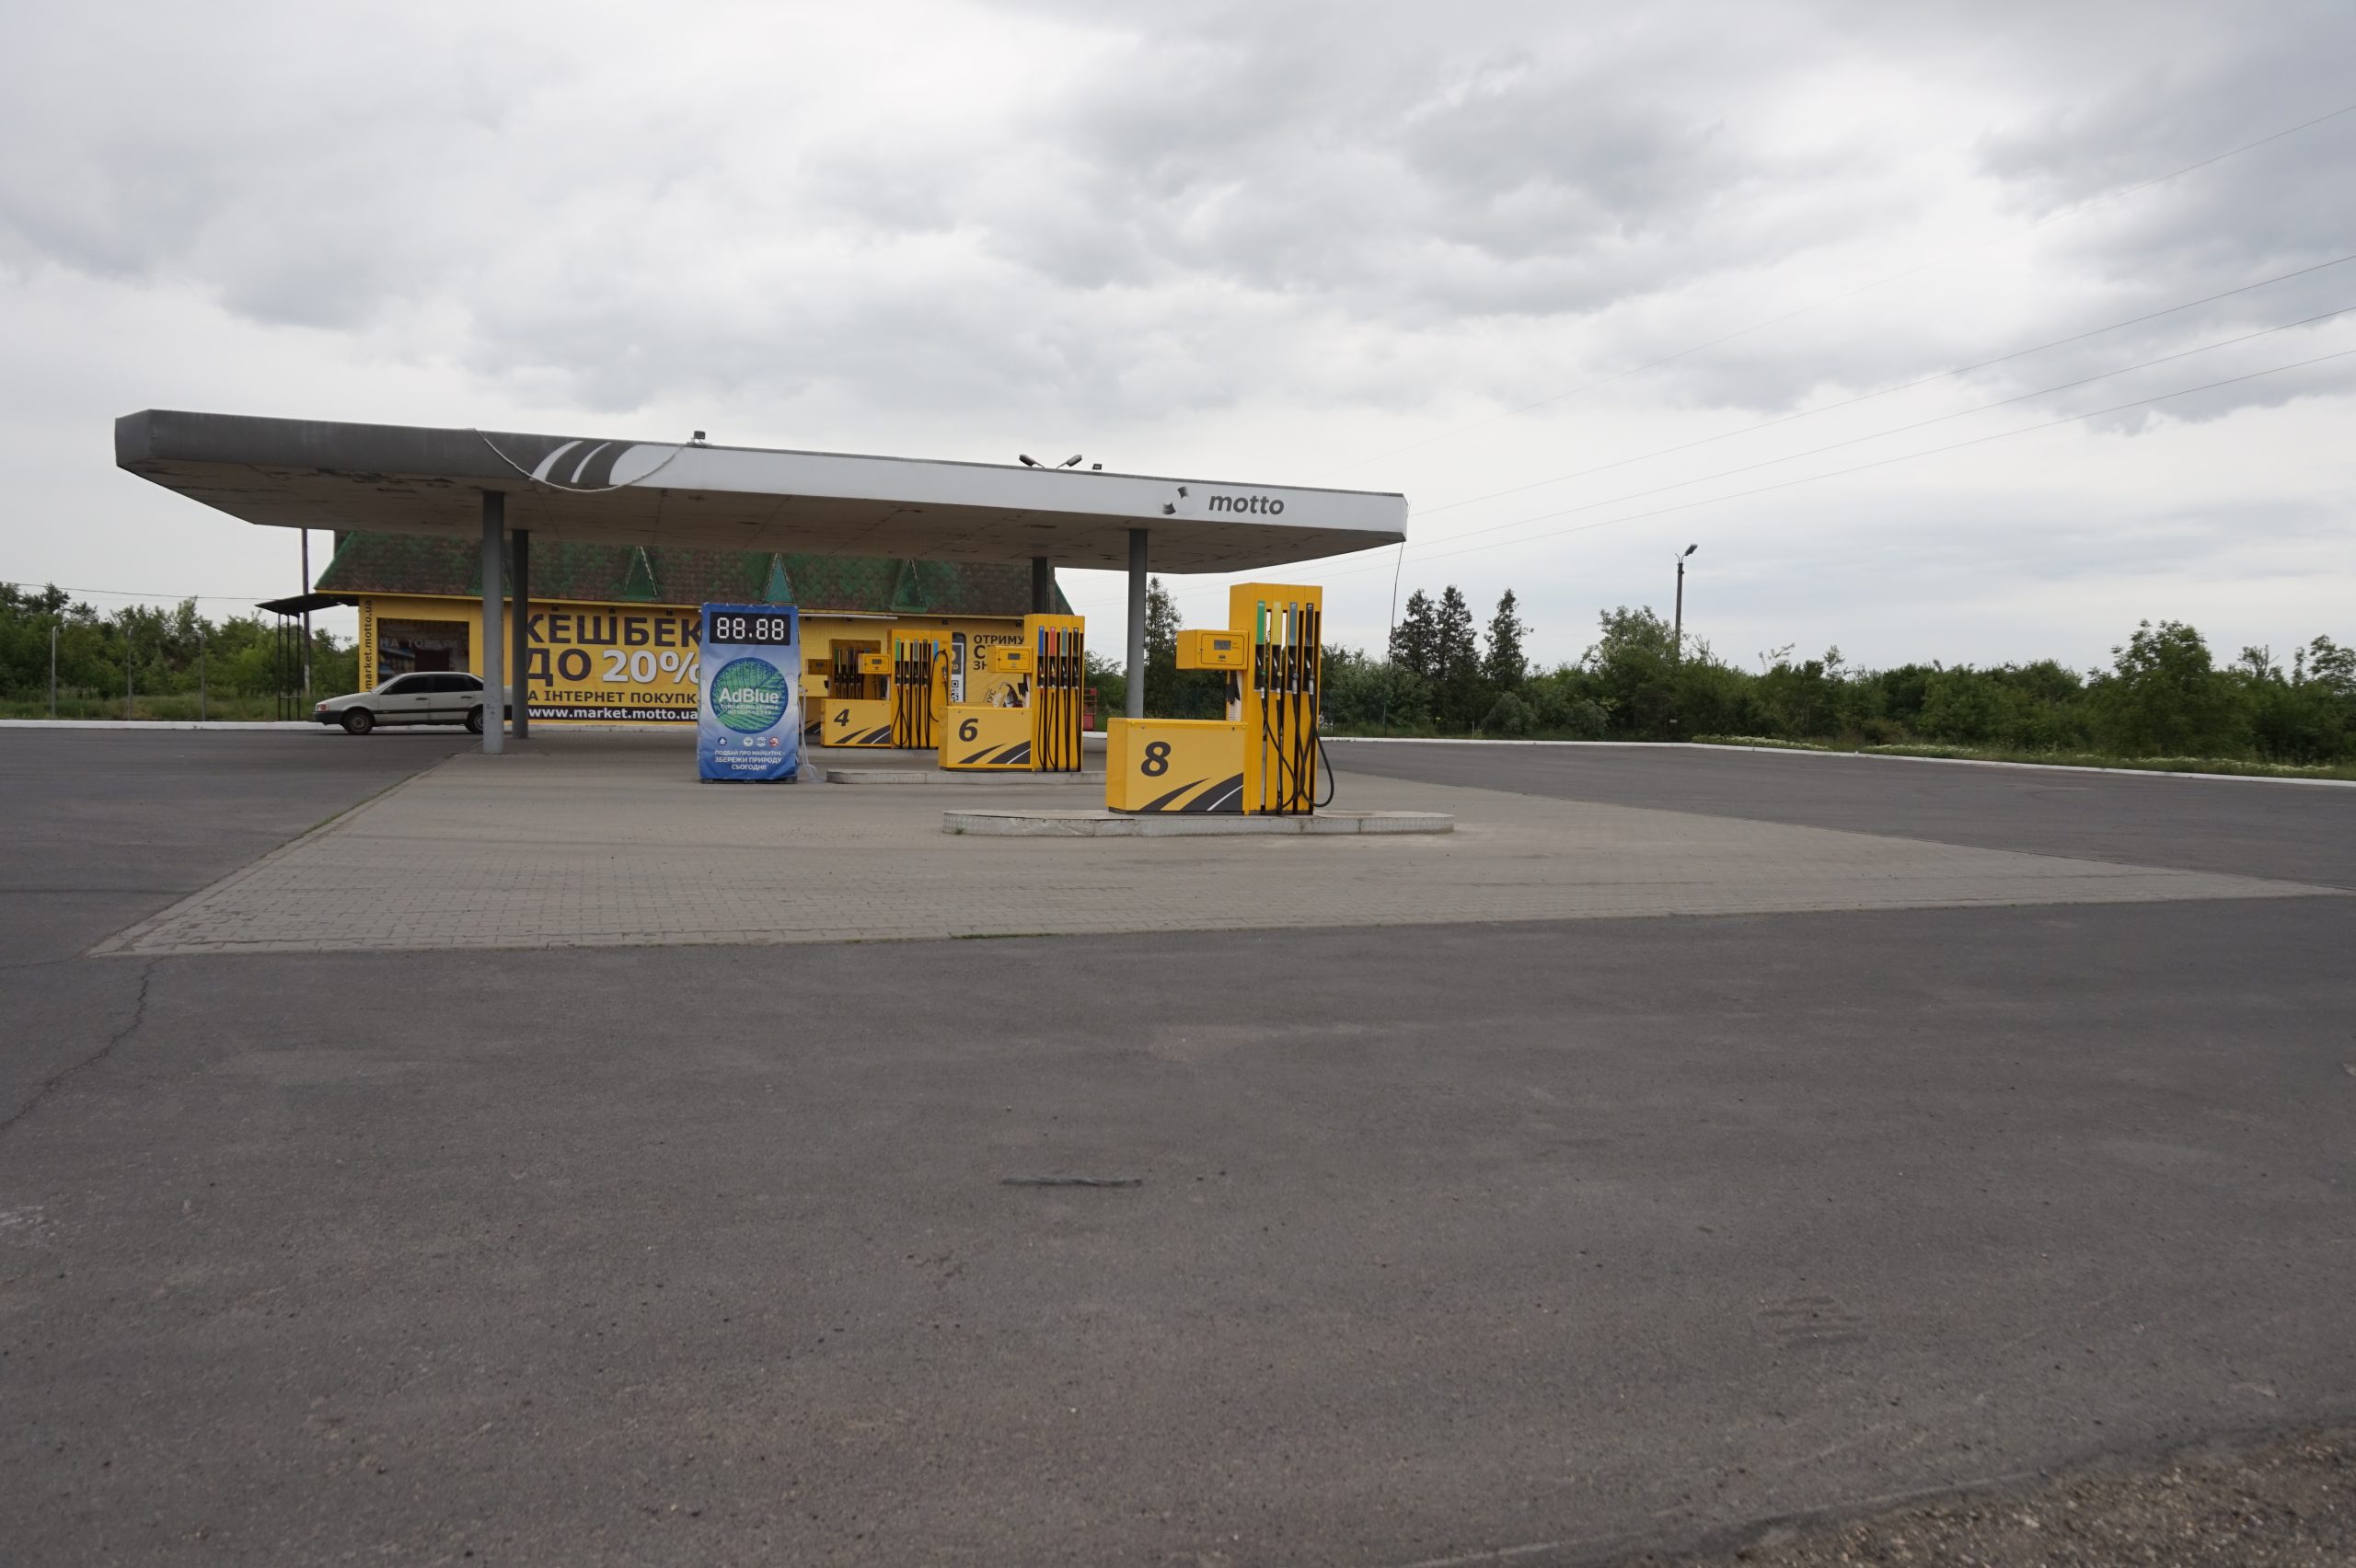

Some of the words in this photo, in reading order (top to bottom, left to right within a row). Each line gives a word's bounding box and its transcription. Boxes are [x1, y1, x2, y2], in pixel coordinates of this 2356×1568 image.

[1208, 495, 1285, 515] motto
[527, 613, 702, 647] КЕШБЕК
[717, 617, 784, 640] 88.88
[973, 634, 1024, 645] ОТРИМУ
[527, 648, 592, 687] ДО
[603, 650, 700, 684] 20%
[527, 690, 538, 701] А
[544, 691, 626, 703] ІНТЕРНЕТ
[630, 692, 697, 705] ПОКУПК
[719, 686, 780, 703] AdBlue
[528, 707, 699, 721] www.market.motto.ua
[834, 709, 849, 727] 4
[958, 718, 979, 743] 6
[1140, 741, 1172, 778] 8
